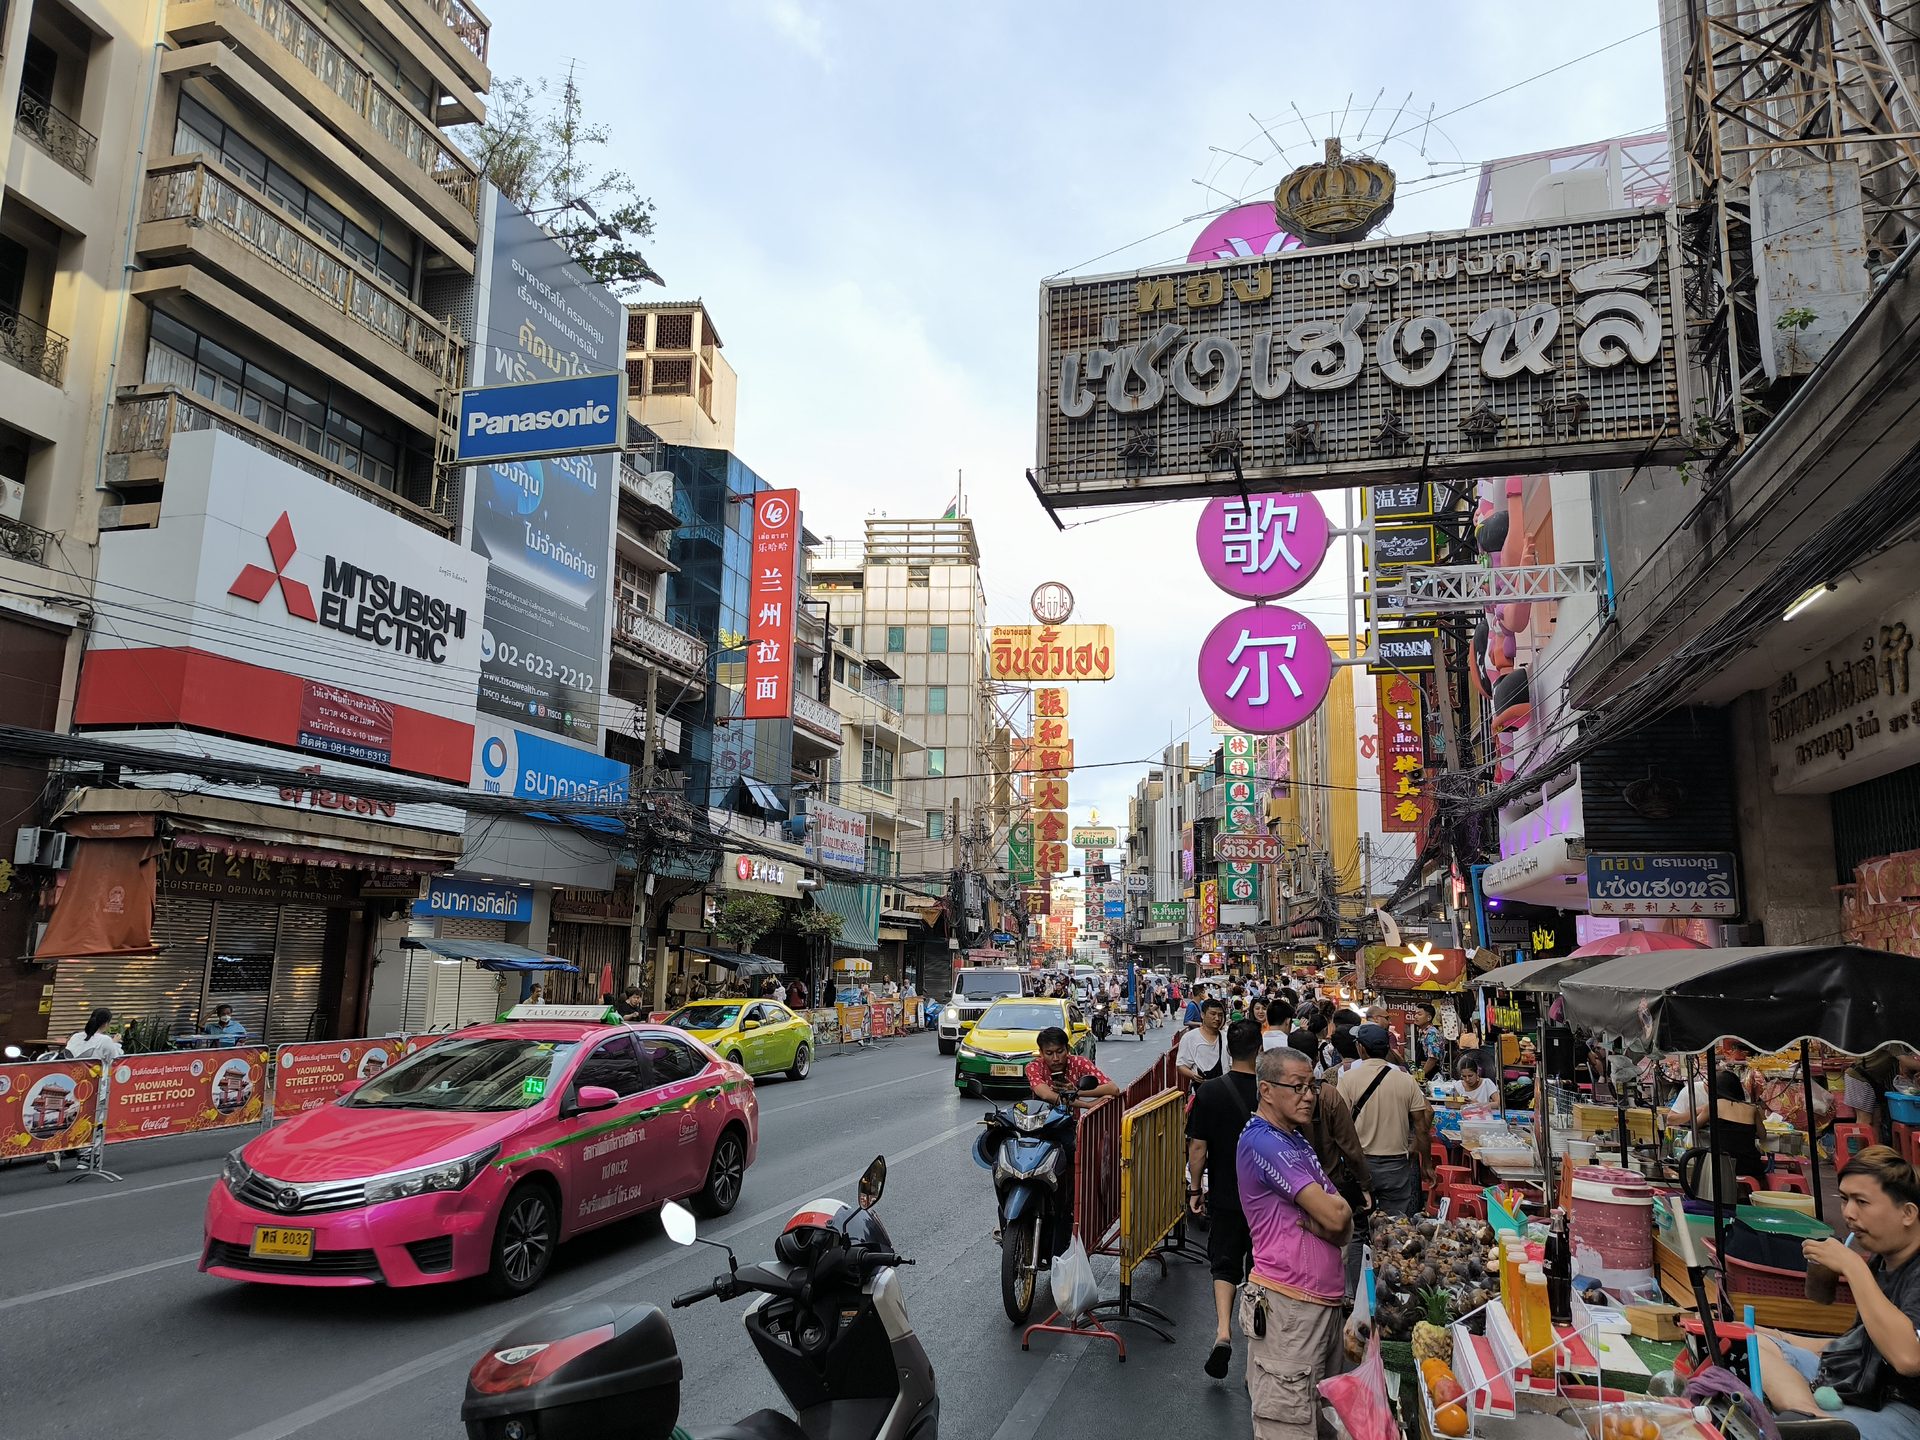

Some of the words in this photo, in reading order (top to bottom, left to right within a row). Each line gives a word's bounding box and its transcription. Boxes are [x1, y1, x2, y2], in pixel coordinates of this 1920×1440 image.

[1135, 268, 1273, 314] ทอง
[512, 258, 565, 312] ธนาคารทิสโก้
[567, 309, 604, 345] ครอบคลุม
[467, 400, 610, 437] Panasonic
[525, 521, 596, 579] ไม่จำกัดค่าย
[758, 541, 788, 553] 乐哈哈
[322, 555, 466, 639] MITSUBISHI
[319, 599, 447, 664] ELECTRIC
[756, 568, 782, 700] 兰州拉面
[498, 642, 594, 694] 02-623-2212
[500, 695, 525, 710] Advisory
[319, 706, 338, 718] ขนาด
[340, 711, 348, 720] 45
[310, 719, 340, 734] หน้ากว้าง
[341, 727, 351, 736] 4.5
[301, 733, 328, 747] ติดต่อ
[330, 743, 347, 754] 081
[350, 746, 365, 757] 940
[368, 750, 388, 763] 6313
[484, 779, 500, 794] TISCO
[1222, 840, 1277, 857] ทองใบ
[1600, 857, 1644, 871] ทอง
[156, 878, 222, 893] REGISTERED
[228, 885, 277, 897] ORDINARY
[1597, 872, 1730, 897] เซ่งเฮงหลี
[431, 891, 517, 915] ธนาคารทิสโก้
[1601, 901, 1726, 913] 成興利大金行
[296, 1065, 335, 1075] YAOWARAJ
[134, 1078, 184, 1090] YAOWARAJ
[286, 1075, 319, 1087] STREET
[321, 1073, 344, 1083] FOOD
[120, 1091, 163, 1105] STREET
[165, 1088, 195, 1100] FOOD
[611, 1159, 629, 1176] 8032
[283, 1231, 308, 1245] 8032
